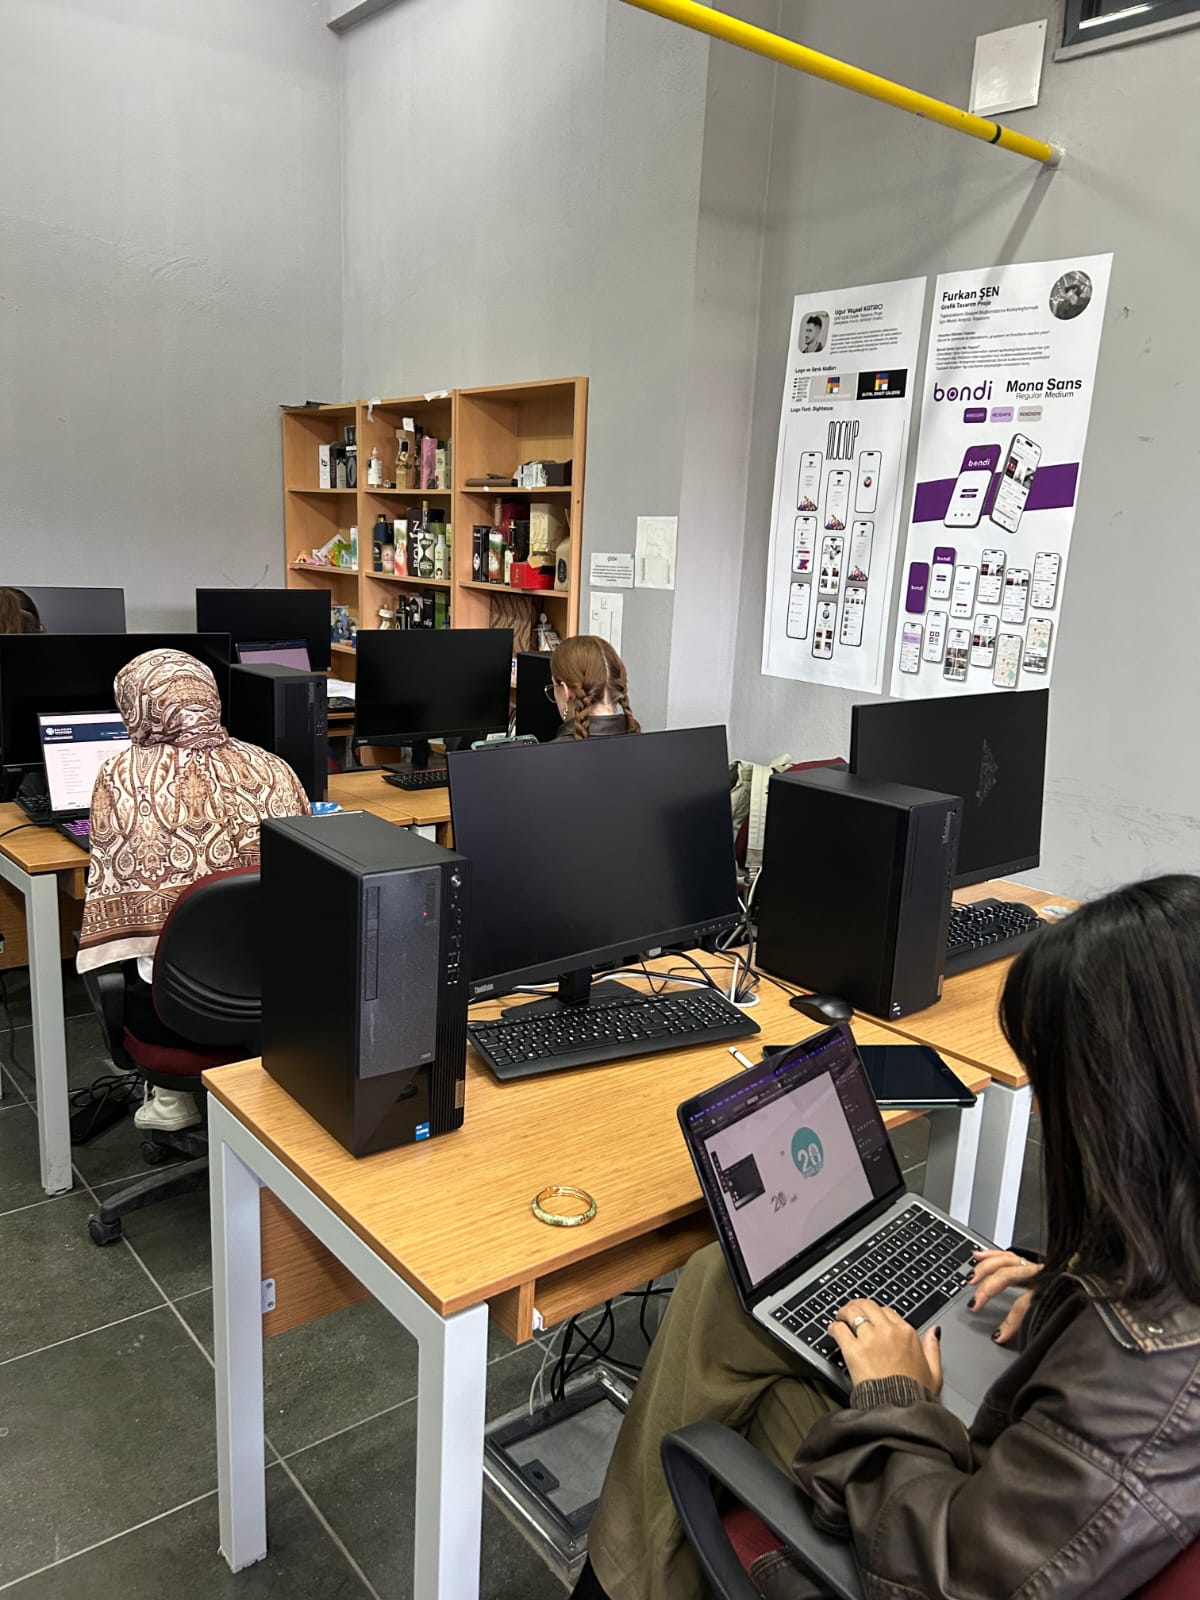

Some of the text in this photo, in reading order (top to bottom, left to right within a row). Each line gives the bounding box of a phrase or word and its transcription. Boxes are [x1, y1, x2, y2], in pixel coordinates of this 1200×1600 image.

[942, 286, 1000, 302] Furkan ŞEN
[933, 379, 993, 402] bondi
[1006, 378, 1082, 393] Mona Sans
[1016, 392, 1042, 400] Regular
[825, 420, 860, 460] MOCKUP
